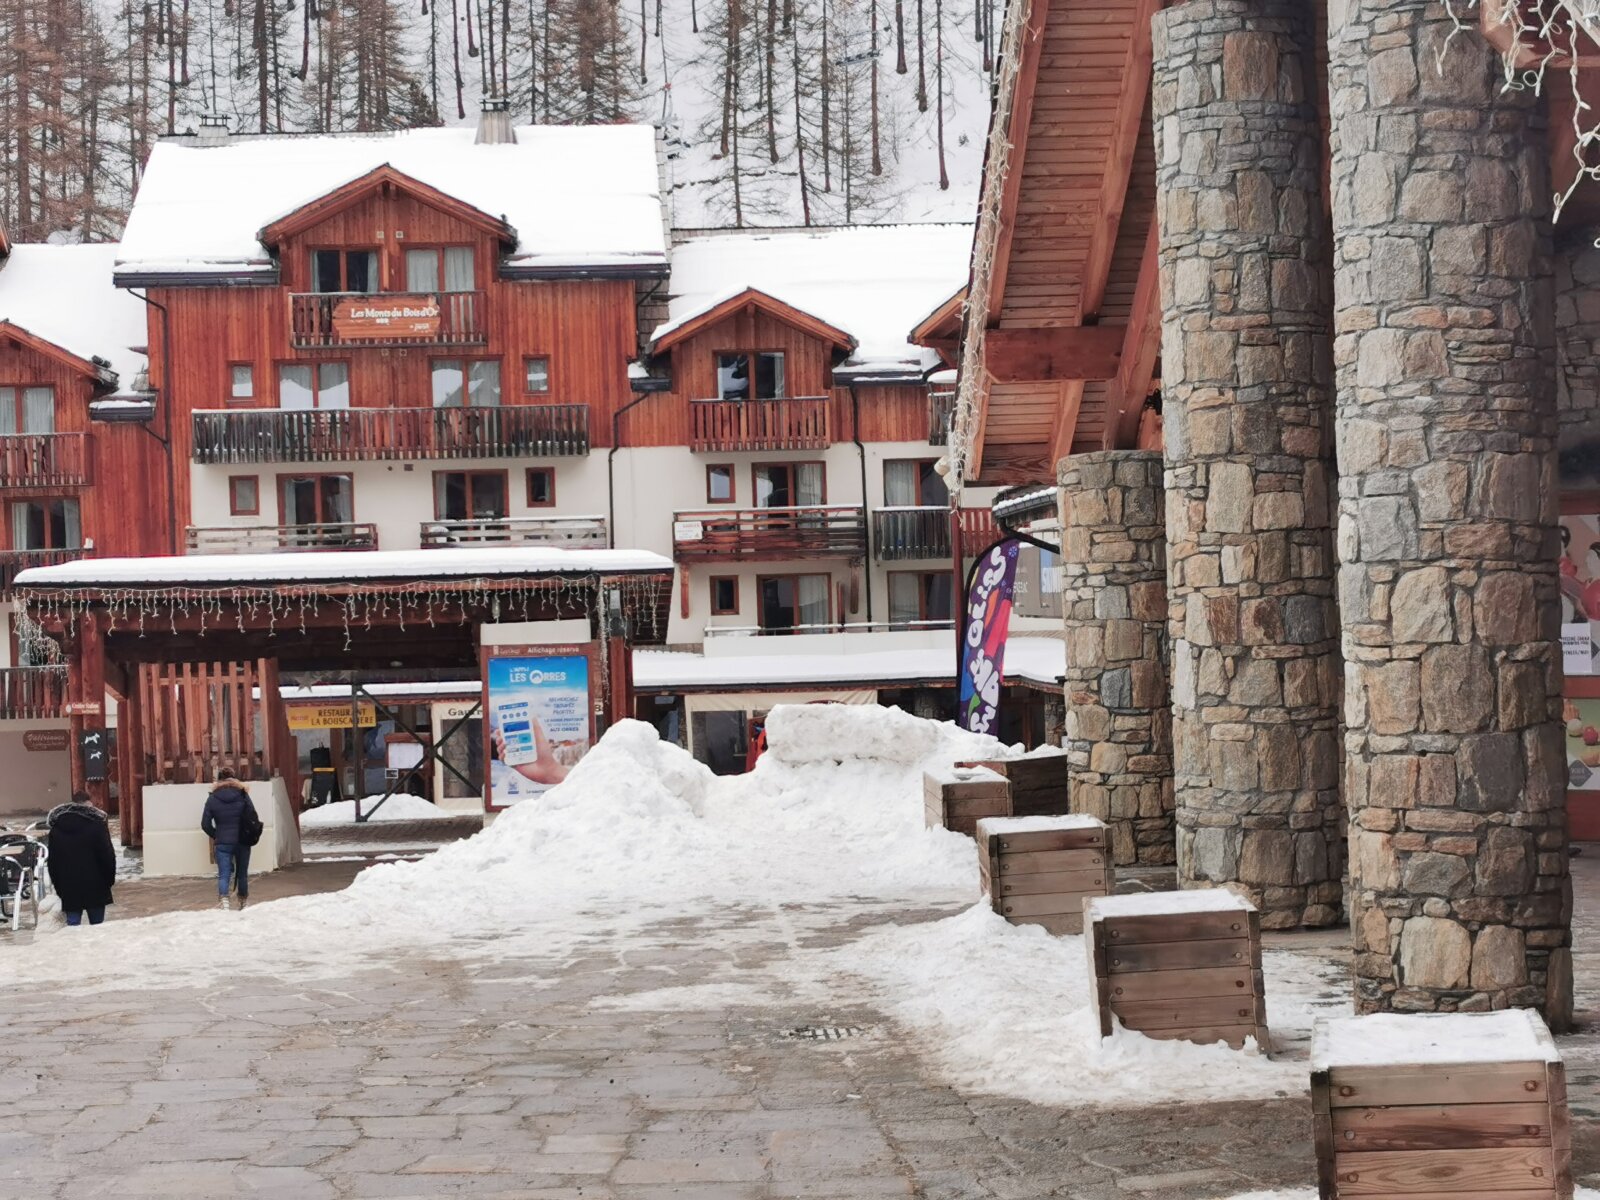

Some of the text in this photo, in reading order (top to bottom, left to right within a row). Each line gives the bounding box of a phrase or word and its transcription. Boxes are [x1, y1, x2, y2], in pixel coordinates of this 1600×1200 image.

[351, 308, 364, 318] Les
[365, 308, 391, 318] Monts
[392, 307, 402, 317] du
[510, 670, 566, 684] LES ORRES
[318, 708, 367, 716] RESTAURNT
